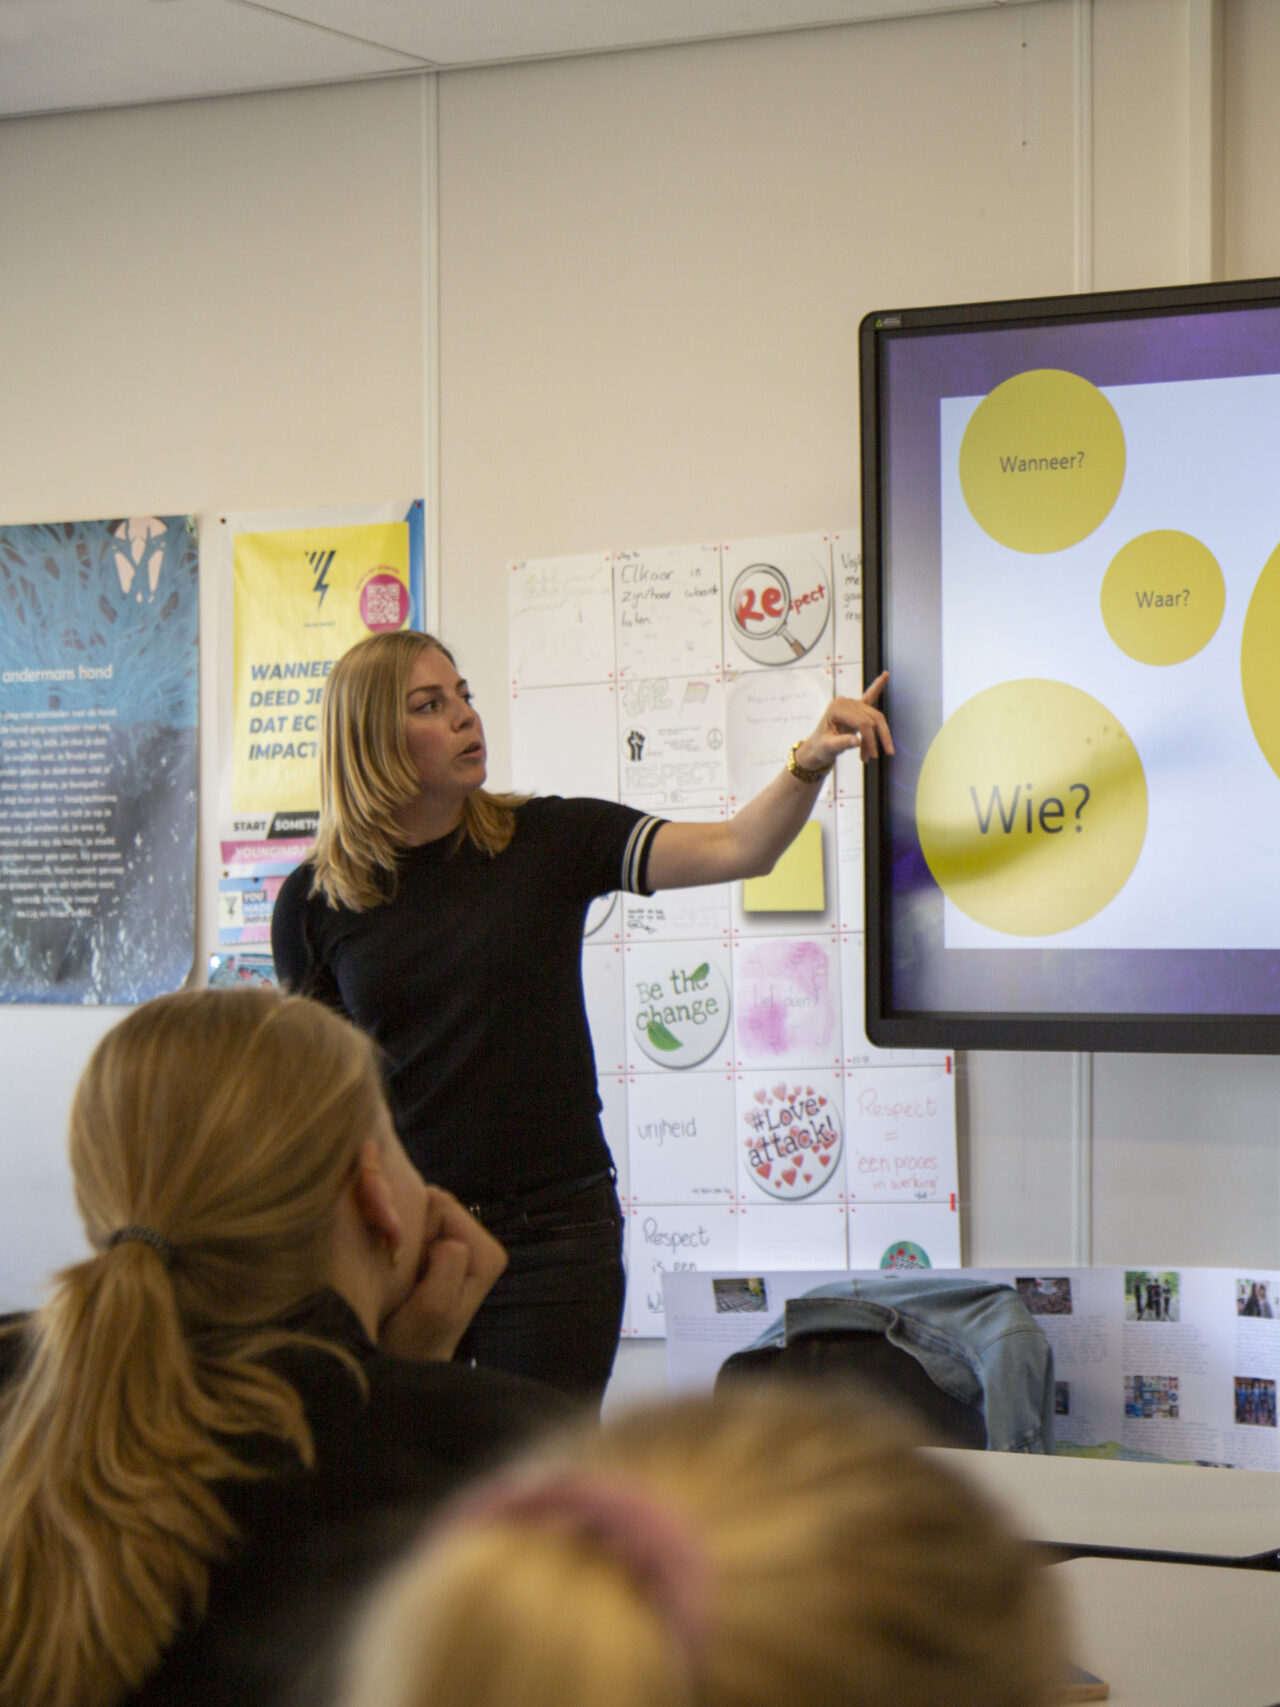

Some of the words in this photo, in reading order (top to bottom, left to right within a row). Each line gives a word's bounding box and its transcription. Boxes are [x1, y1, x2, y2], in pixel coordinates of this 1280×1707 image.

[999, 451, 1085, 473] Wanneer?
[1136, 589, 1190, 609] Waar?
[249, 689, 301, 707] DEED
[249, 716, 288, 735] DAT
[248, 741, 318, 761] IMPACT
[969, 782, 1090, 834] Wie?
[233, 821, 267, 832] START
[634, 981, 664, 1004] Be
[669, 967, 709, 995] the
[635, 997, 720, 1031] change
[752, 1098, 820, 1132] #Love
[857, 1086, 938, 1122] Respect
[747, 1114, 835, 1168] attack!
[643, 1216, 711, 1254] Respect
